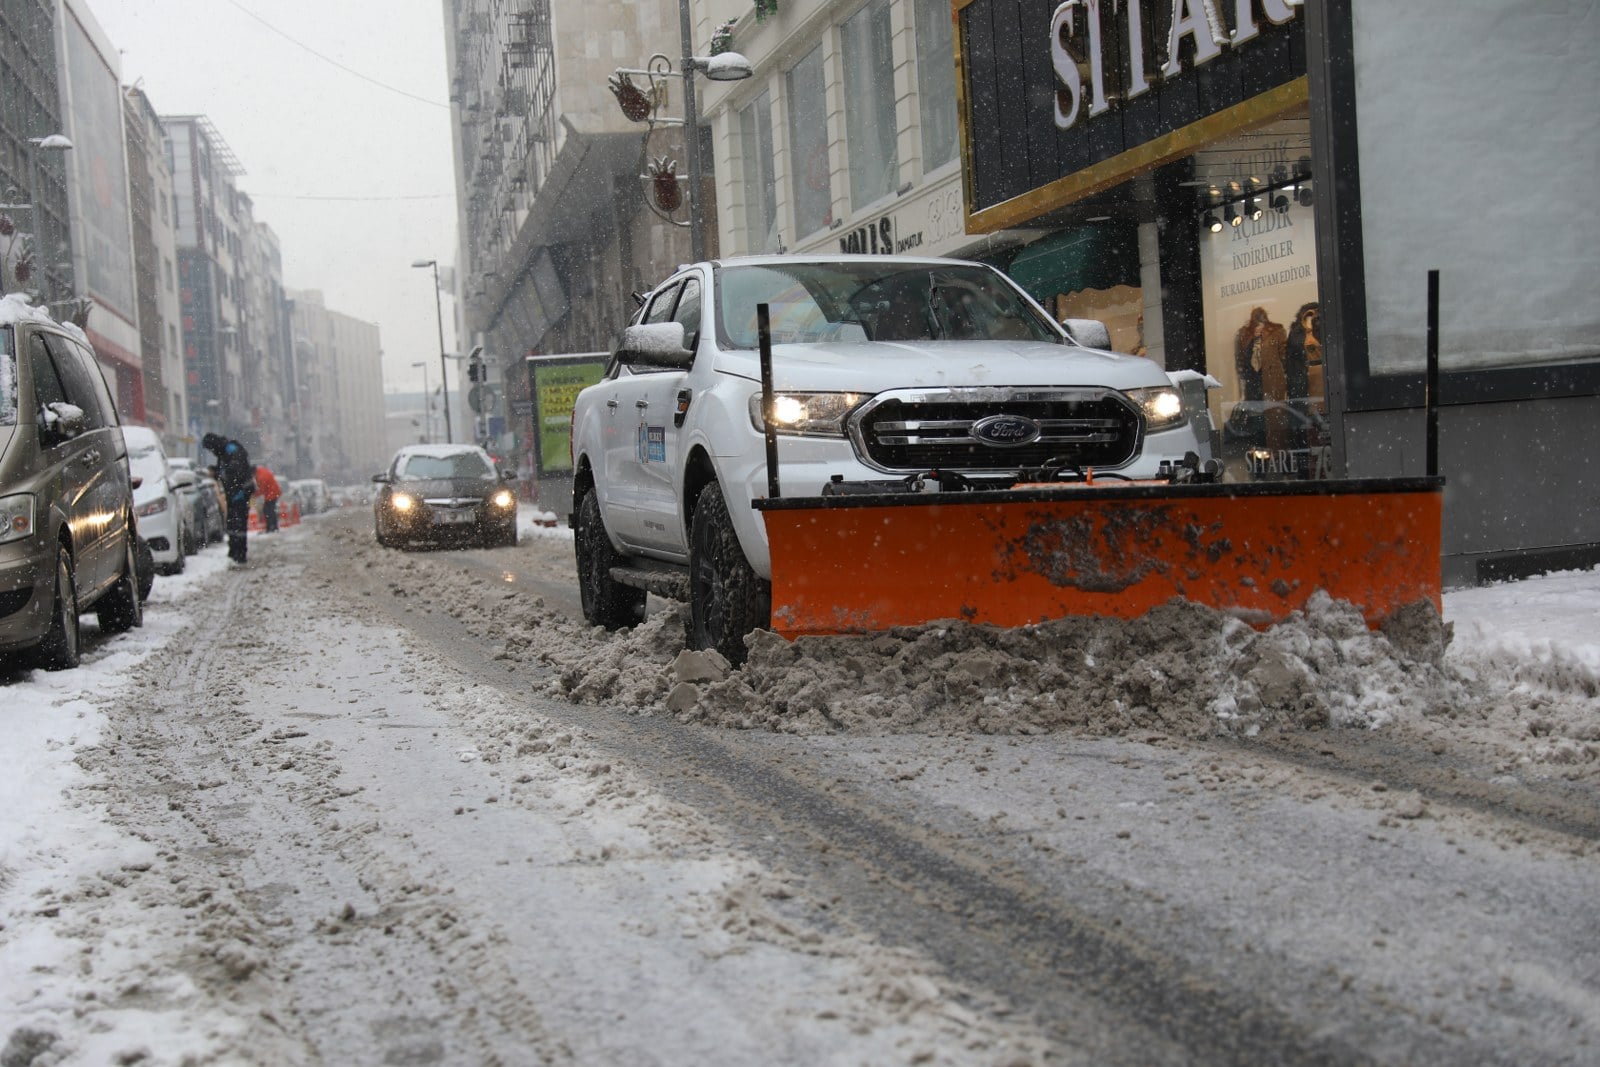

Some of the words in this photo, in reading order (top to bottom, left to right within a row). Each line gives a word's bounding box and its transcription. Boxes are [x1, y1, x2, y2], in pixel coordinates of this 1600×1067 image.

[1232, 239, 1294, 271] İNDİRİMLER
[1220, 279, 1251, 298] BURADA
[1251, 272, 1279, 291] DEVAM
[1279, 264, 1311, 284] EDİYOR
[991, 424, 1025, 438] Ford
